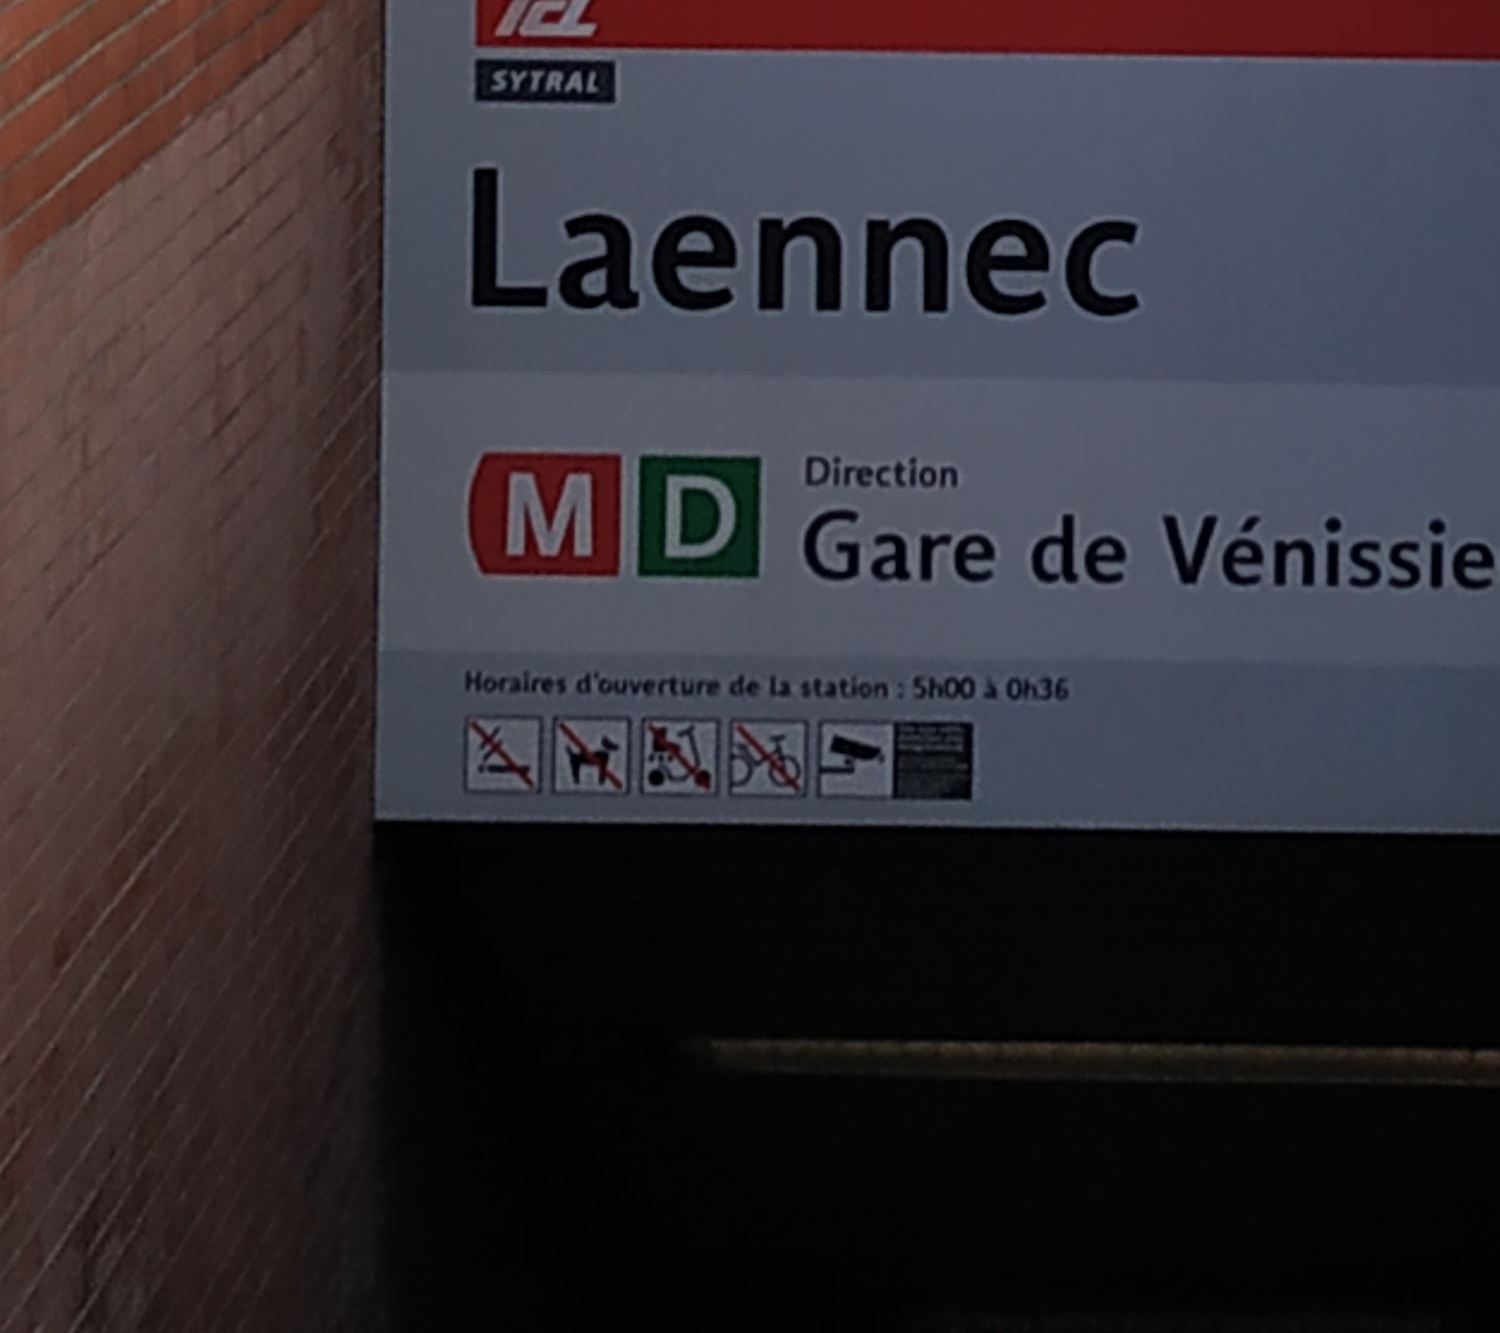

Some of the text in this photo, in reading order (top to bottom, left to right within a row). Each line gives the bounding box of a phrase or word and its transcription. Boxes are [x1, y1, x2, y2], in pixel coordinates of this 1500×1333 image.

[488, 68, 602, 95] SYTRAL
[470, 166, 1141, 317] Laennec
[804, 457, 960, 489] Direction
[504, 473, 738, 559] M D
[802, 509, 998, 584] Gare
[1030, 513, 1128, 586] de
[464, 670, 568, 695] Horaires
[576, 671, 721, 697] d'ouverture
[728, 674, 762, 698] de
[769, 674, 792, 699] la
[801, 676, 890, 700] station
[912, 676, 976, 701] 5h00
[983, 677, 998, 700] à
[1004, 677, 1071, 702] 0h36
